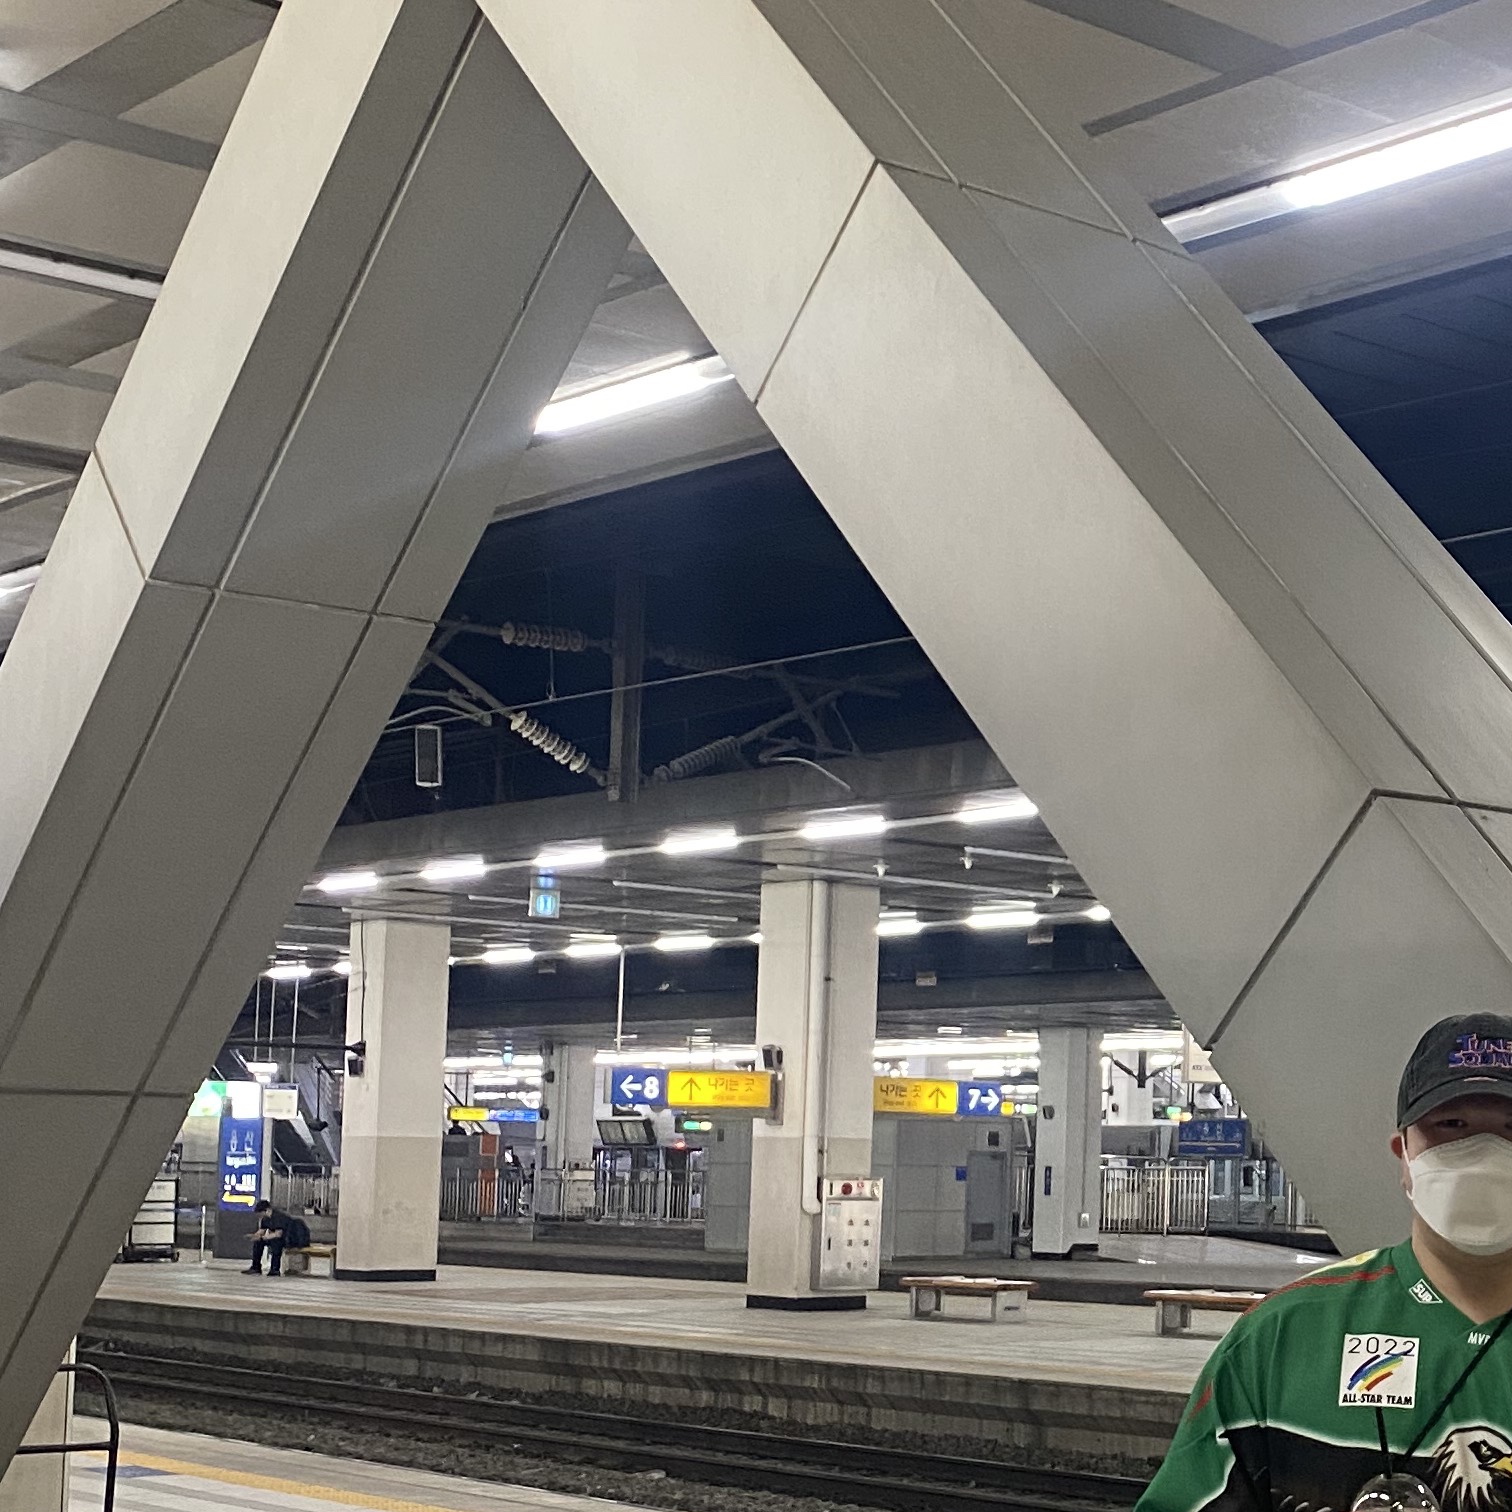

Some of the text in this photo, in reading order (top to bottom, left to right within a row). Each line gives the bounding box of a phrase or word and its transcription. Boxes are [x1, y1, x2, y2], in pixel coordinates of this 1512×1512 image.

[643, 1076, 660, 1100] 8
[744, 1077, 755, 1093] 곳
[912, 1084, 922, 1098] 곳
[968, 1087, 981, 1111] 7
[1348, 1336, 1416, 1357] 2022
[1342, 1393, 1413, 1406] ALL-STAR TEAM
